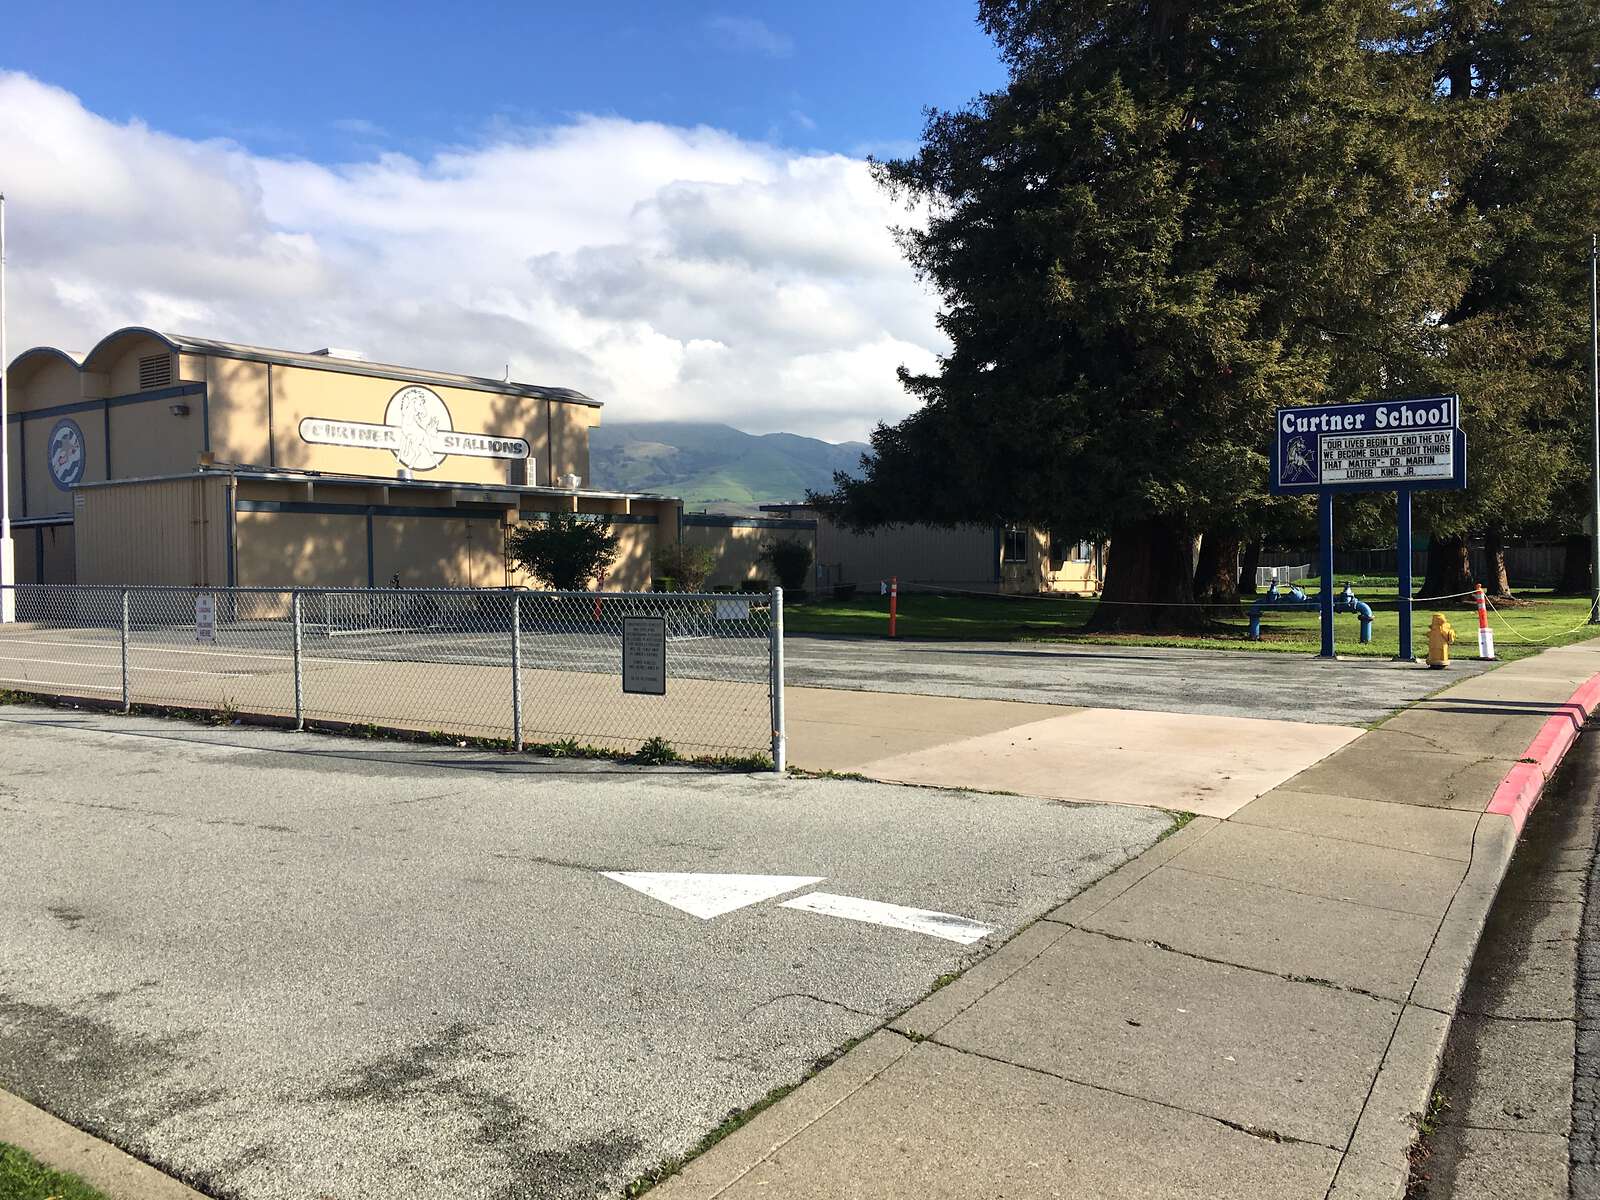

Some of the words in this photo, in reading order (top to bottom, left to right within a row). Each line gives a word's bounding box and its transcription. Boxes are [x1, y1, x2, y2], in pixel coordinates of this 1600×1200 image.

[1282, 413, 1366, 434] Curtner
[1375, 402, 1449, 428] School
[444, 436, 523, 455] STALLIONS
[1344, 439, 1364, 448] LIVES
[1366, 438, 1388, 447] BEGIN
[1389, 437, 1398, 446] TO
[1402, 436, 1417, 444] END
[1419, 435, 1432, 444] THE
[1434, 434, 1450, 442] DAY
[1323, 451, 1334, 459] WE
[1338, 450, 1366, 459] BECOME
[1370, 448, 1394, 457] SILENT
[1396, 446, 1420, 456] ABOUT
[1423, 444, 1450, 454] THINGS
[1324, 460, 1342, 470] THAT
[1406, 456, 1435, 465] MARTIN
[1346, 469, 1373, 478] LUTHER
